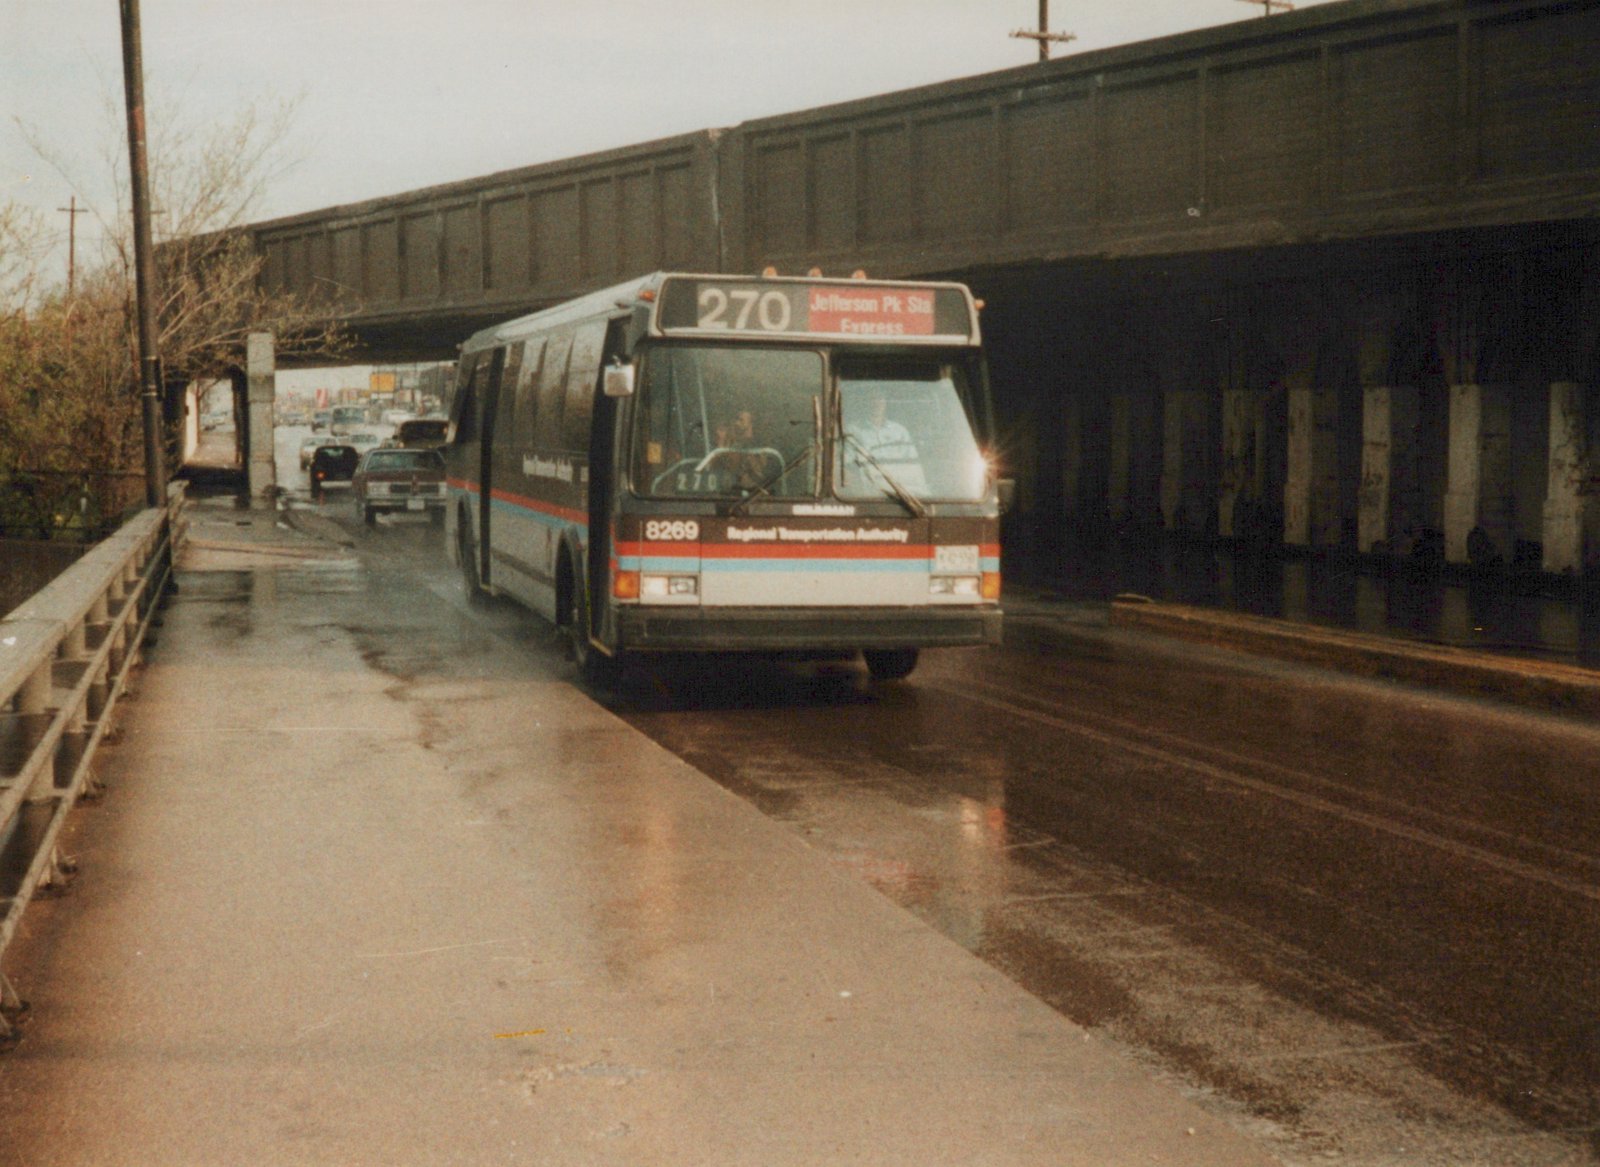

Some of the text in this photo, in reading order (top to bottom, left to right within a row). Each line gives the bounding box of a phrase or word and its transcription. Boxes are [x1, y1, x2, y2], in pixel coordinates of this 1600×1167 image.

[698, 287, 791, 332] 270
[810, 294, 878, 312] Jefferson
[882, 295, 901, 313] Pk
[840, 318, 904, 335] Express
[646, 520, 699, 540] 8269
[727, 526, 908, 543] Regional Transportation Authority
